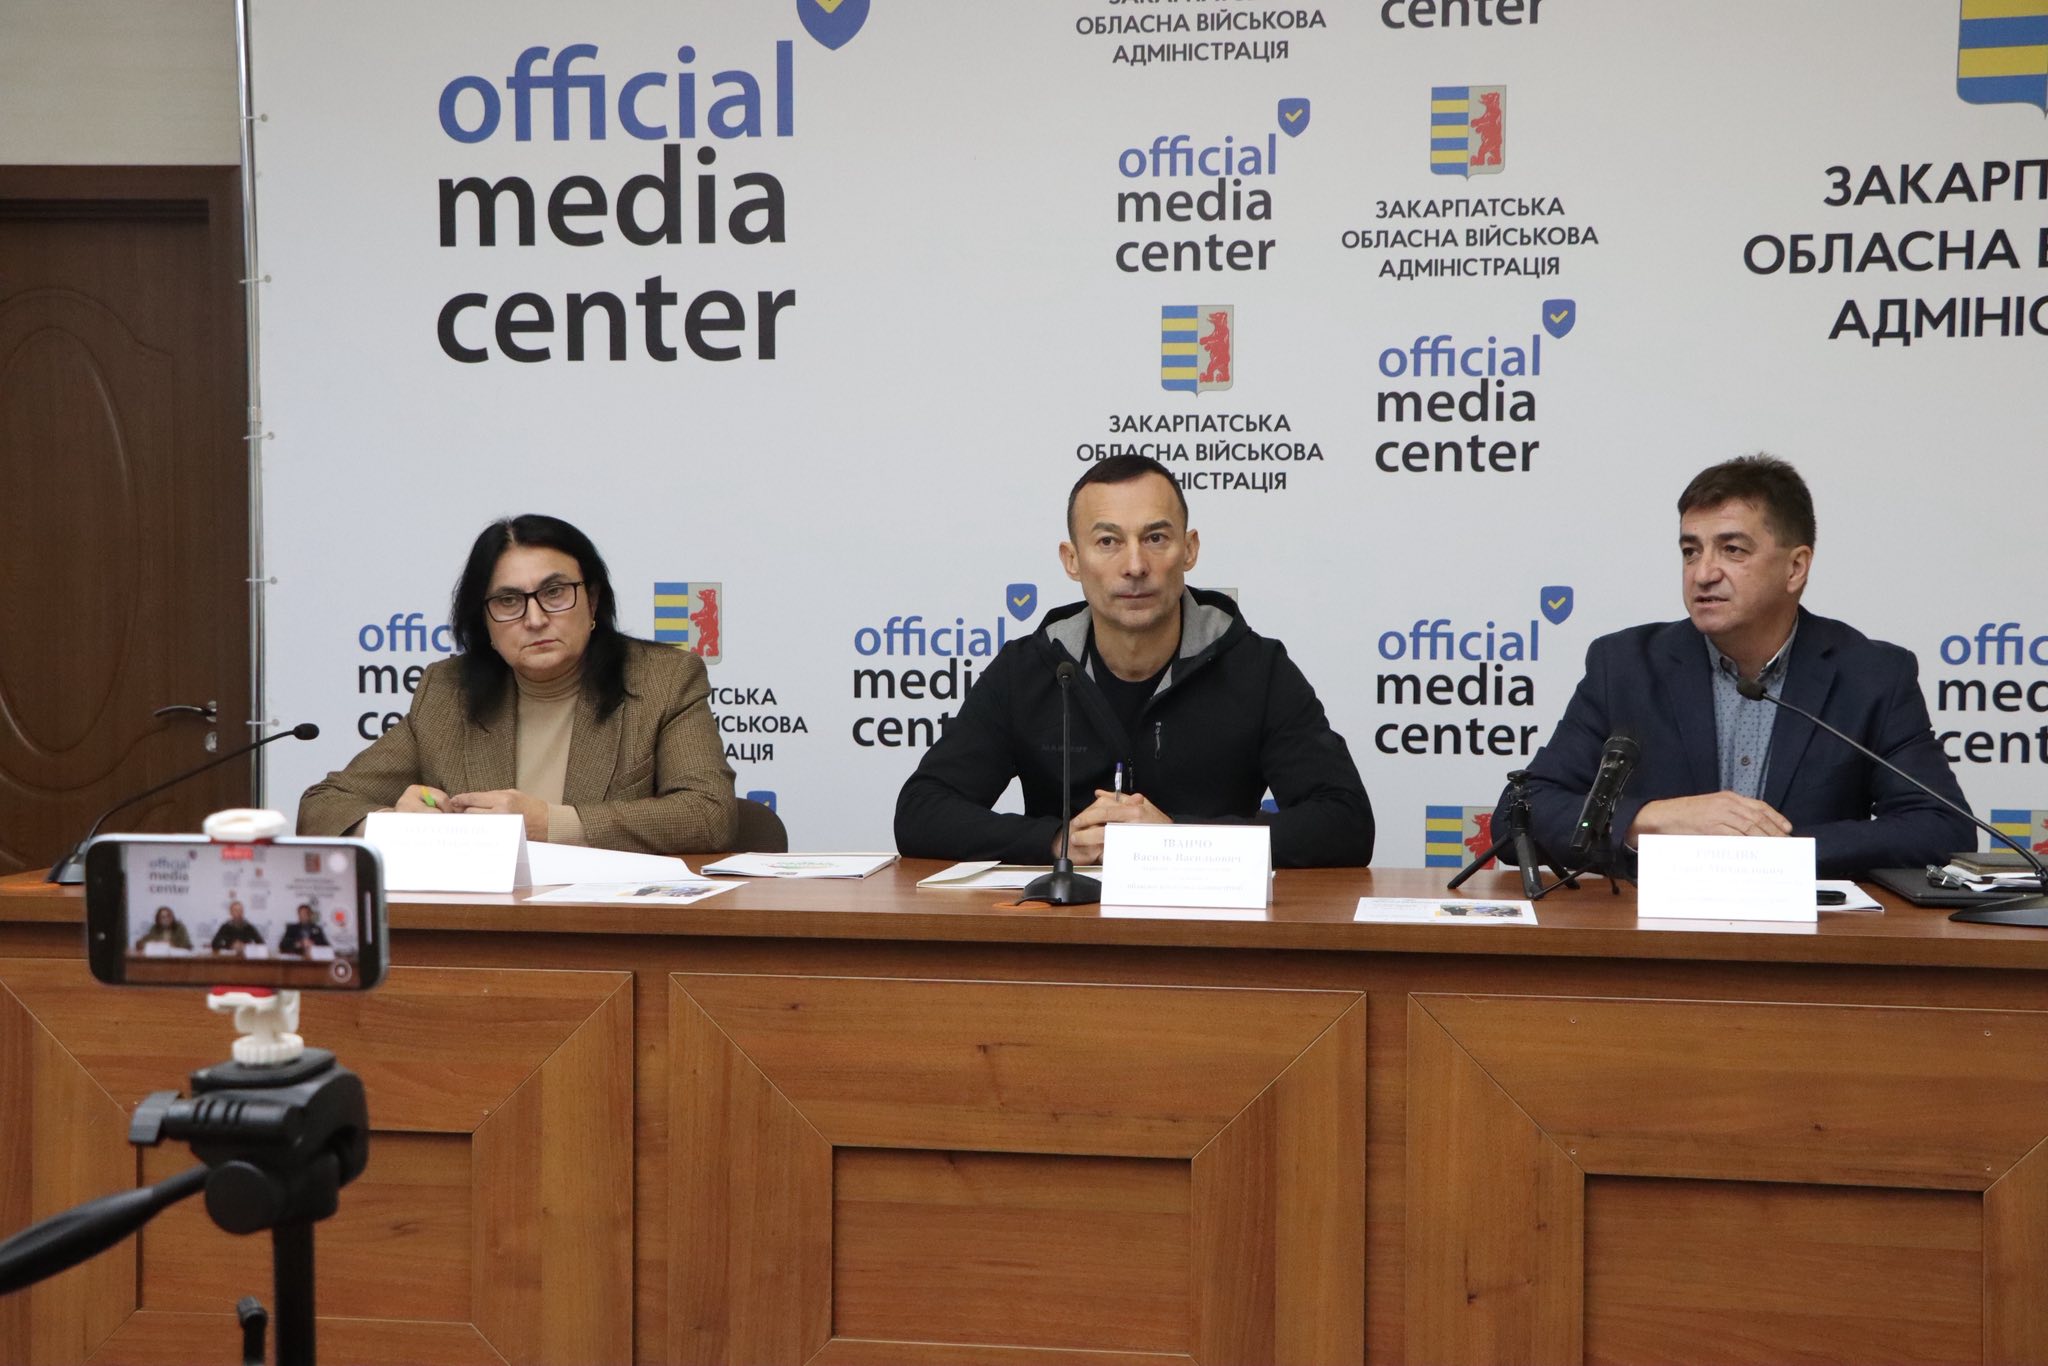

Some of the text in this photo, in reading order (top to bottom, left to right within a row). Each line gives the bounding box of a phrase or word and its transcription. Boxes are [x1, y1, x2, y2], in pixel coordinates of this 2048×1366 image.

[1075, 9, 1327, 35] ОБЛАСНА ВІЙСЬКОВА
[1380, 0, 1544, 29] center
[1112, 40, 1289, 67] АДМІНІСТРАЦІЯ
[438, 40, 795, 144] official
[1118, 134, 1277, 178] official
[438, 144, 787, 248] media
[1117, 178, 1272, 223] media
[1375, 196, 1566, 219] ЗАКАРПАТСЬКА
[1115, 233, 1276, 273] center
[1341, 225, 1599, 250] ОБЛАСНА ВІЙСЬКОВА
[1743, 228, 2021, 275] ОБЛАСНА
[1378, 256, 1560, 281] АДМІНІСТРАЦІЯ
[437, 275, 796, 364] center
[1378, 334, 1541, 378] official
[1377, 378, 1536, 423] media
[1109, 414, 1292, 433] ЗАКАРПАТСЬКА
[1195, 439, 1324, 462] ВІЙСЬКОВА
[1375, 434, 1540, 473] center
[1173, 471, 1287, 493] НІСТРАЦІЯ
[358, 612, 464, 653] offic
[854, 615, 1006, 657] official
[1377, 618, 1540, 662] official
[853, 657, 984, 701] medi
[1376, 662, 1535, 707] media
[1374, 717, 1539, 756] center
